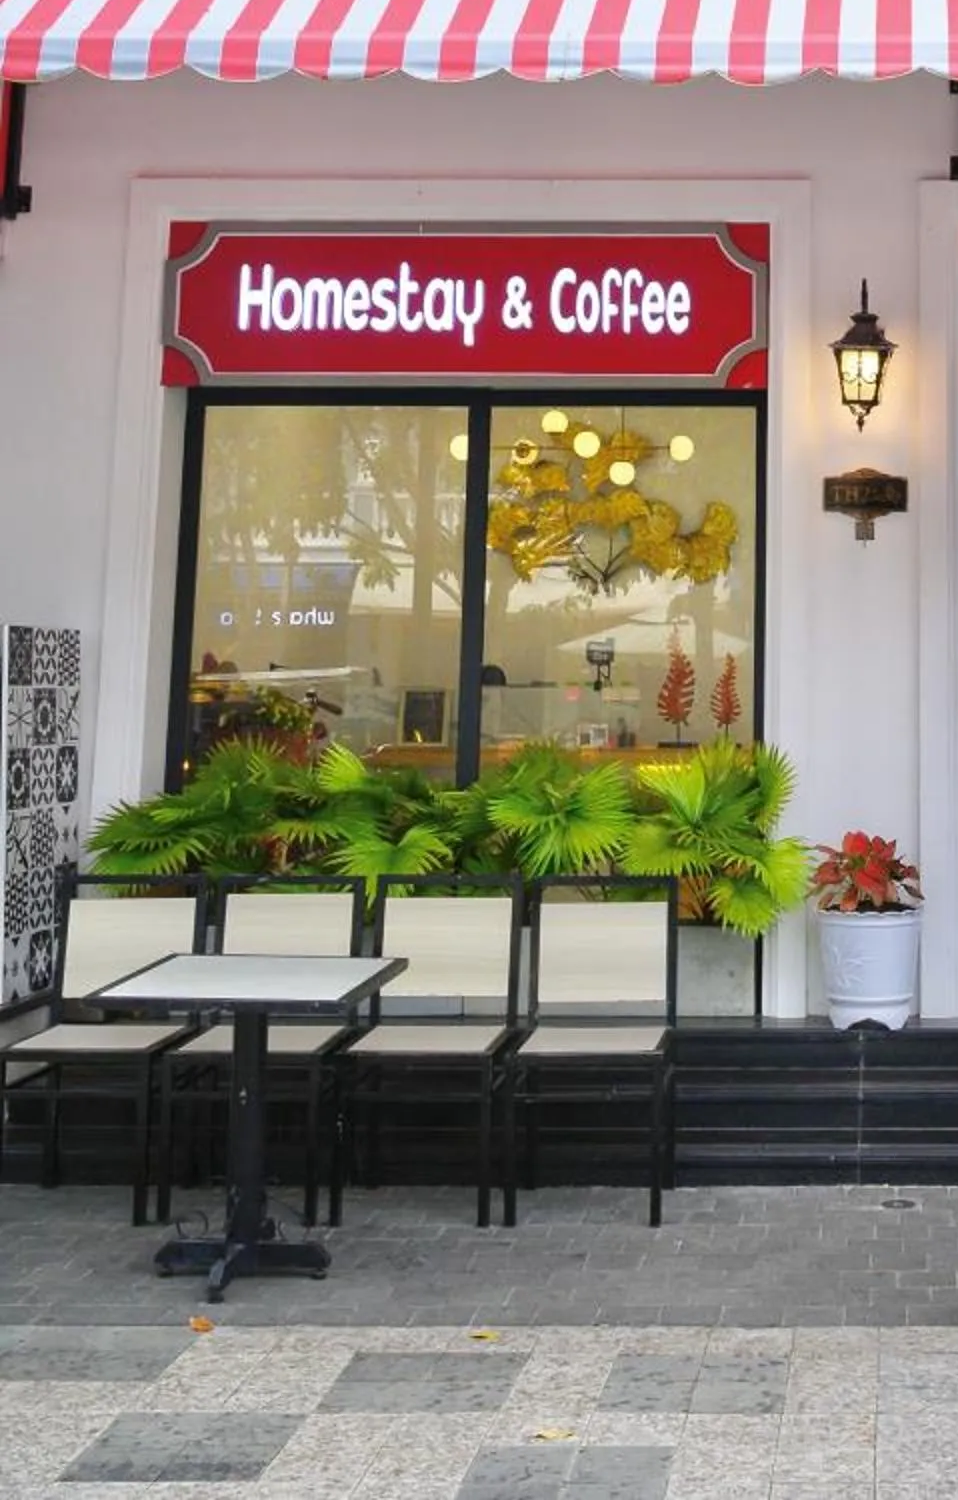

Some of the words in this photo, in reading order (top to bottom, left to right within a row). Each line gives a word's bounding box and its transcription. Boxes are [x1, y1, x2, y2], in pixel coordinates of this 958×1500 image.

[238, 261, 484, 346] Homestay
[502, 275, 533, 330] &
[550, 267, 691, 335] Coffee
